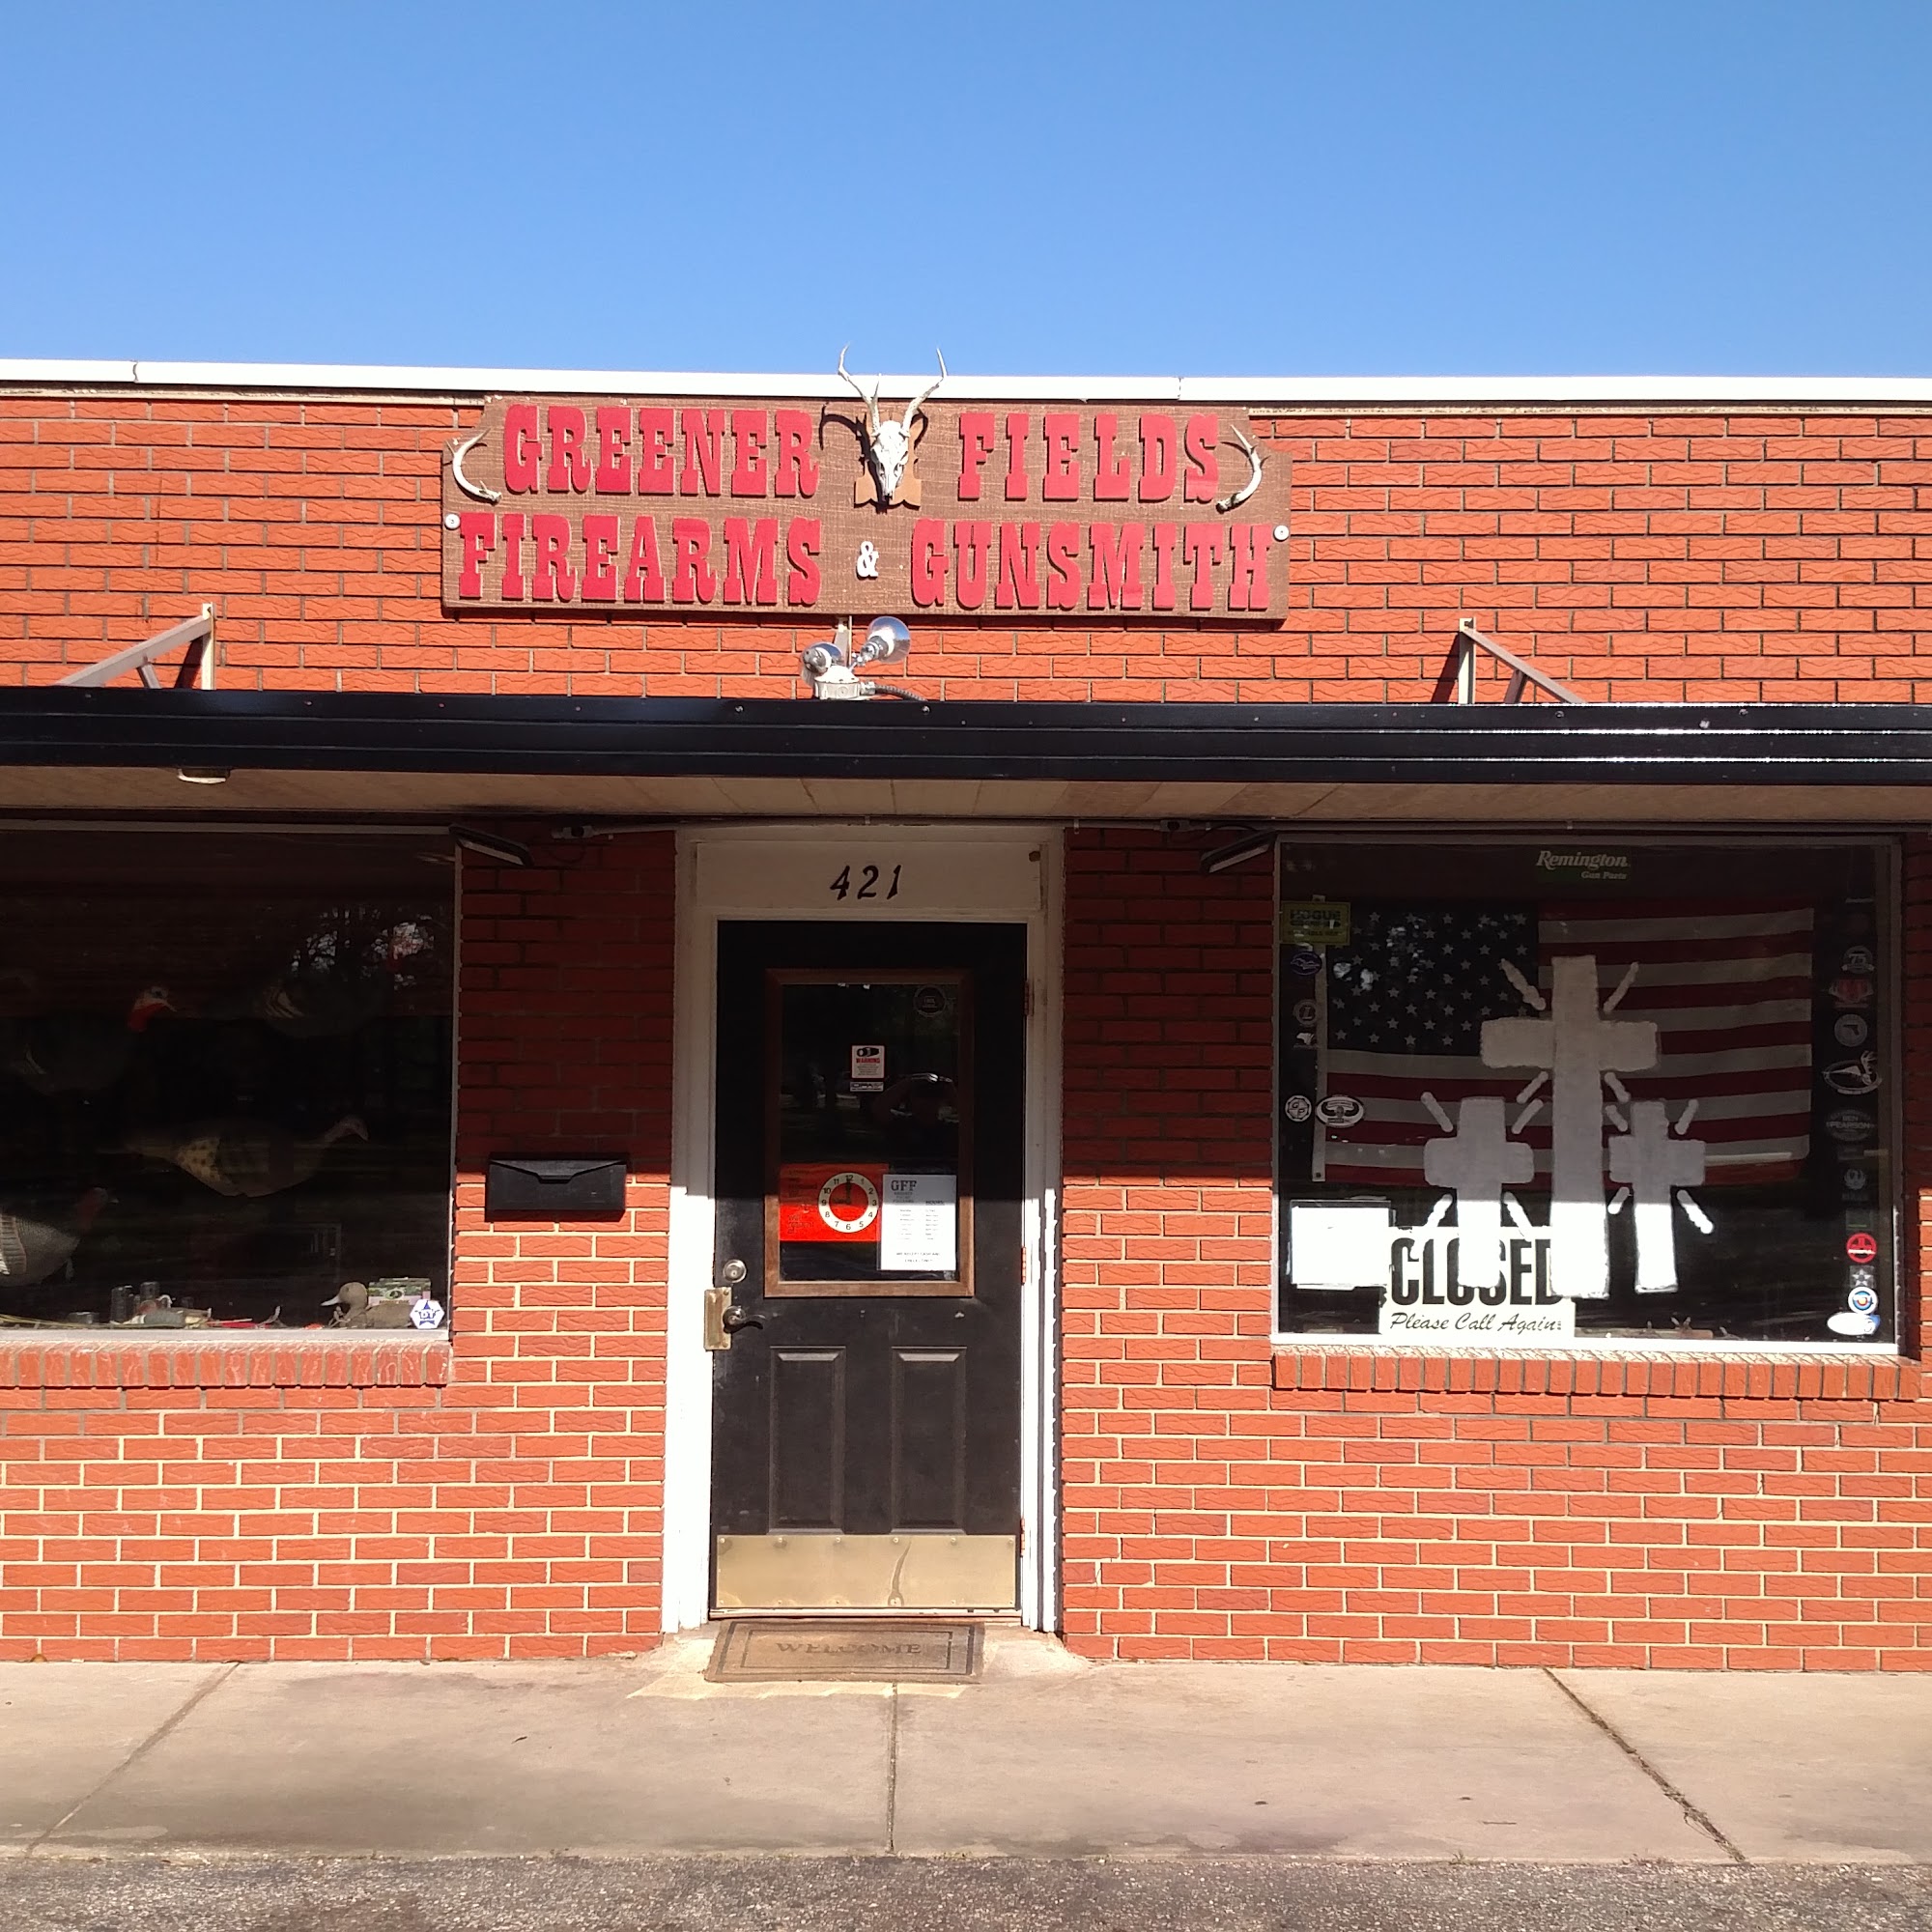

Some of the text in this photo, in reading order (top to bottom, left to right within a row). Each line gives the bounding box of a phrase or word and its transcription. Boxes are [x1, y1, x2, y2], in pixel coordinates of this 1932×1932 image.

[504, 403, 1219, 502] GREENER FIELDS
[458, 513, 1272, 611] FIREARMS & GUNSMITH
[1536, 850, 1629, 870] Remington
[830, 865, 901, 900] 421
[1580, 870, 1628, 880] Gun Parts
[891, 1180, 917, 1191] GFF
[1390, 1312, 1449, 1330] Please
[1455, 1312, 1494, 1330] Call
[1496, 1313, 1556, 1335] Again
[776, 1642, 922, 1654] WELCOME
